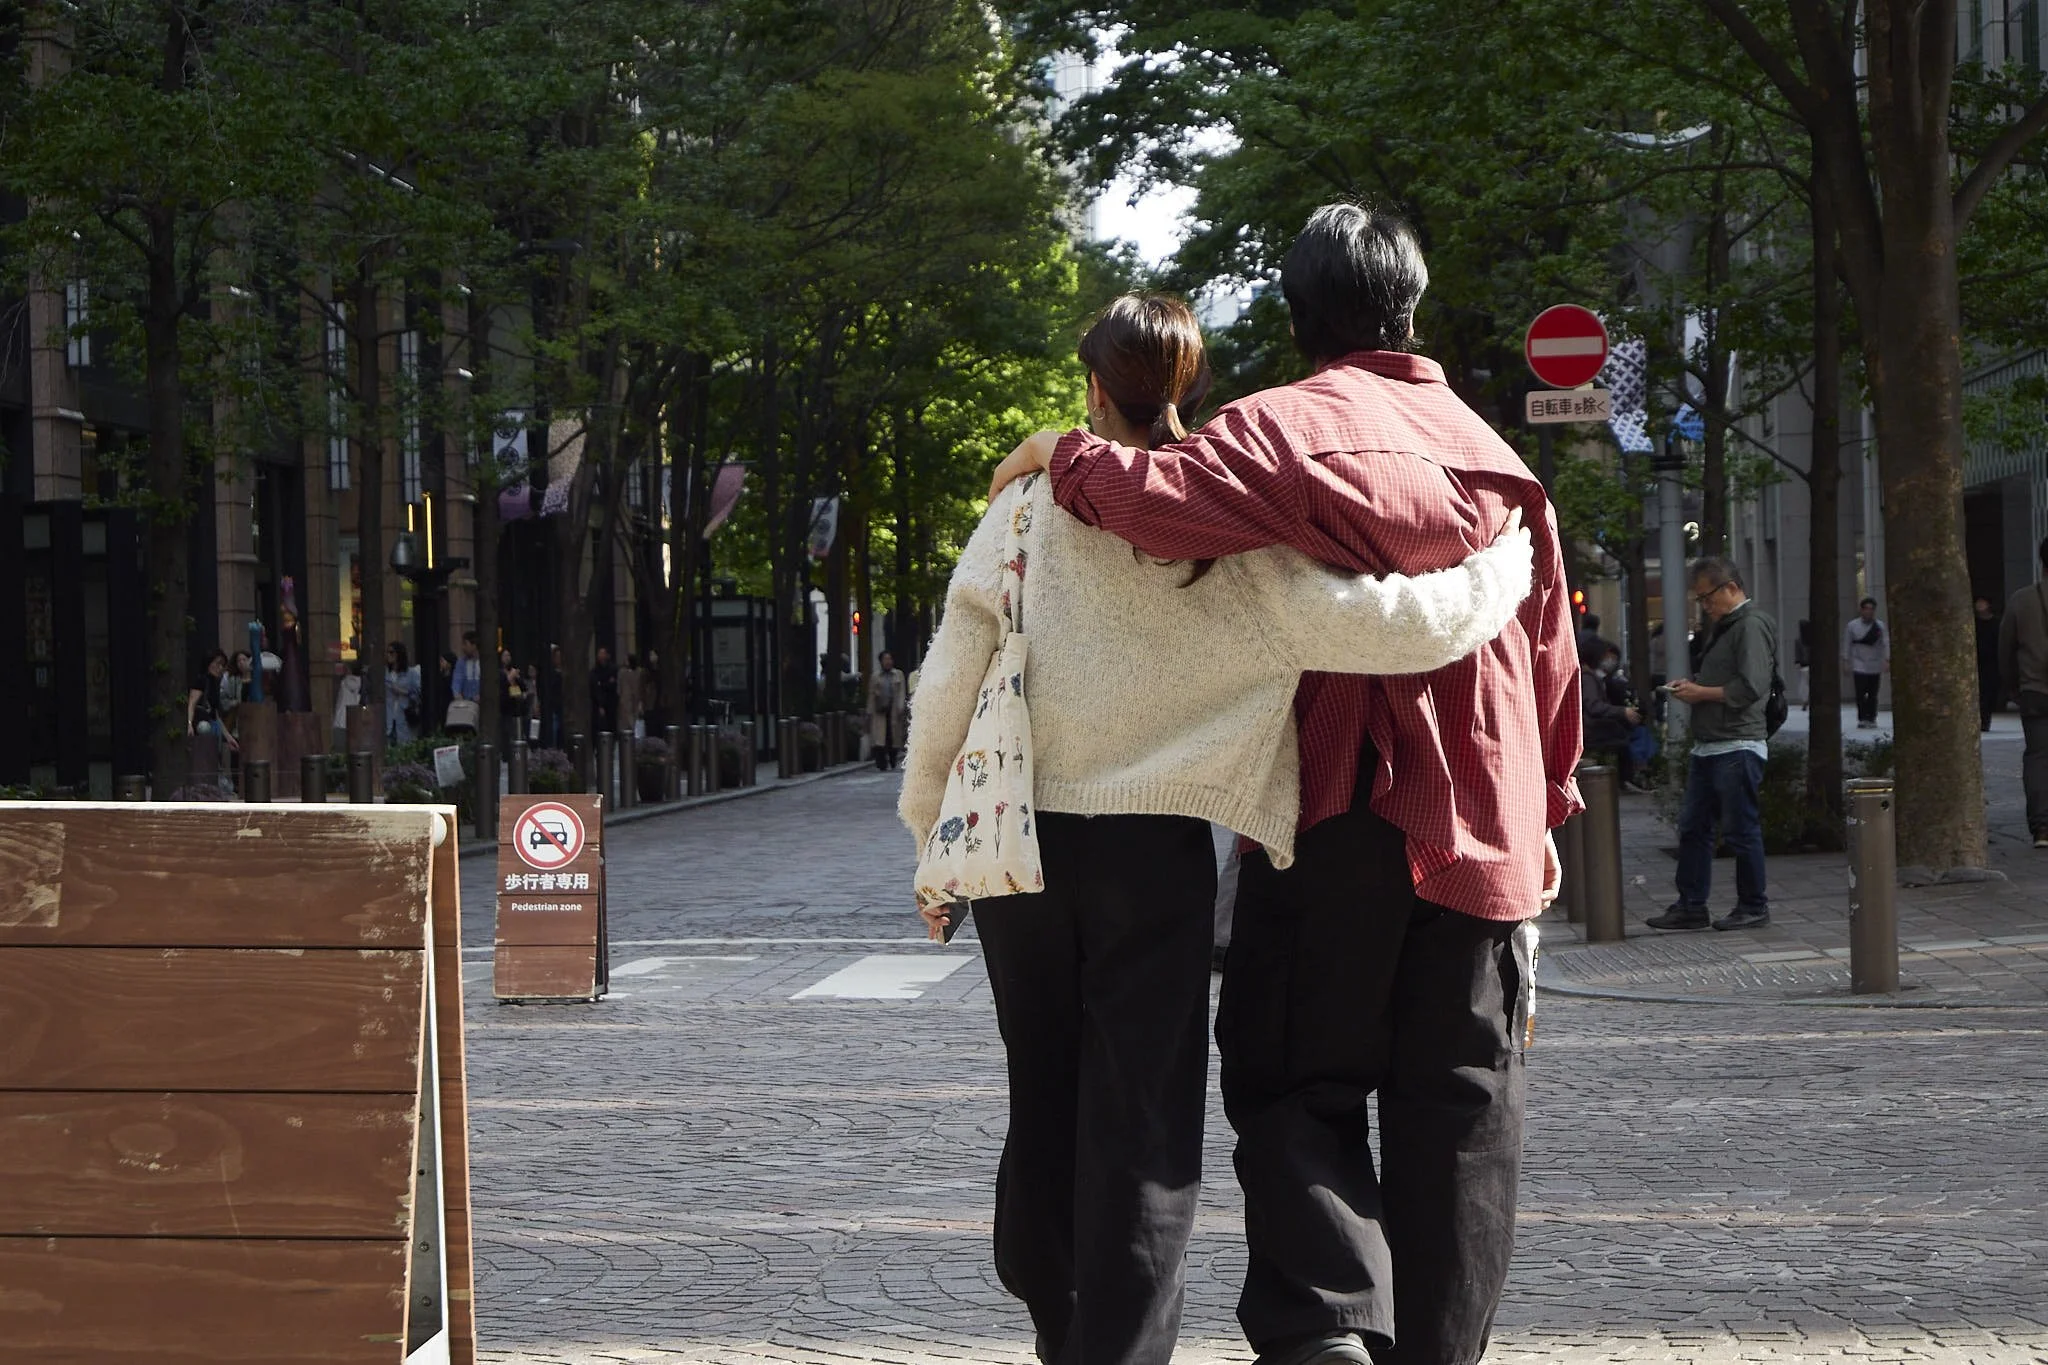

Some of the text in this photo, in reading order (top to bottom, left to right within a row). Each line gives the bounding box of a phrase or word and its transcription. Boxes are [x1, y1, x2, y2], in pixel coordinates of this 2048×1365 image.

[1531, 396, 1606, 416] 自転車を除く
[505, 873, 589, 890] 歩行者専用
[511, 902, 582, 911] Pedestrian zone
